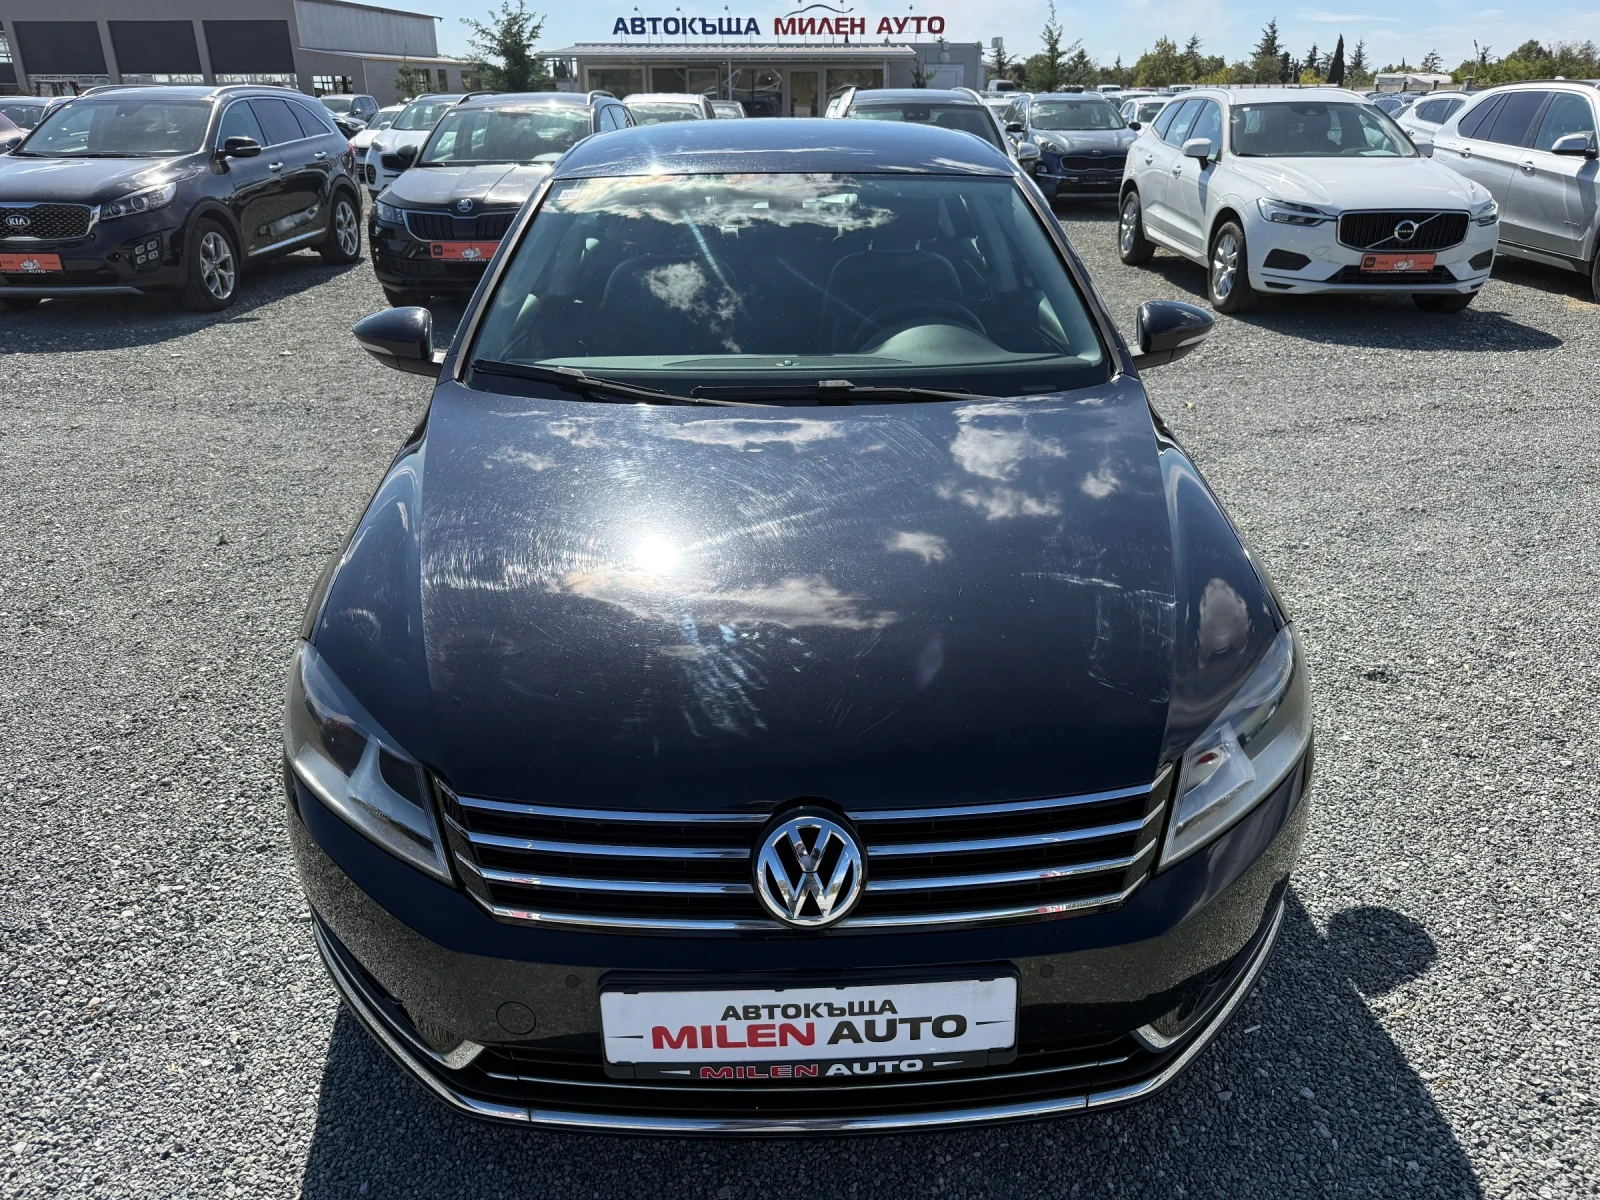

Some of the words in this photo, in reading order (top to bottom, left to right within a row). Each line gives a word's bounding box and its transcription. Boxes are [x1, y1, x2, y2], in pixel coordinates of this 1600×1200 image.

[612, 17, 761, 36] АВТОКЪЩА
[774, 17, 865, 35] МИЛЕН
[876, 16, 946, 35] АУТО
[8, 217, 26, 226] KIA
[721, 999, 898, 1021] АВТОКЪЩА
[651, 1022, 816, 1050] MILEN
[826, 1014, 968, 1046] AUTO
[699, 1064, 819, 1079] MILEN
[825, 1058, 924, 1076] AUTO
